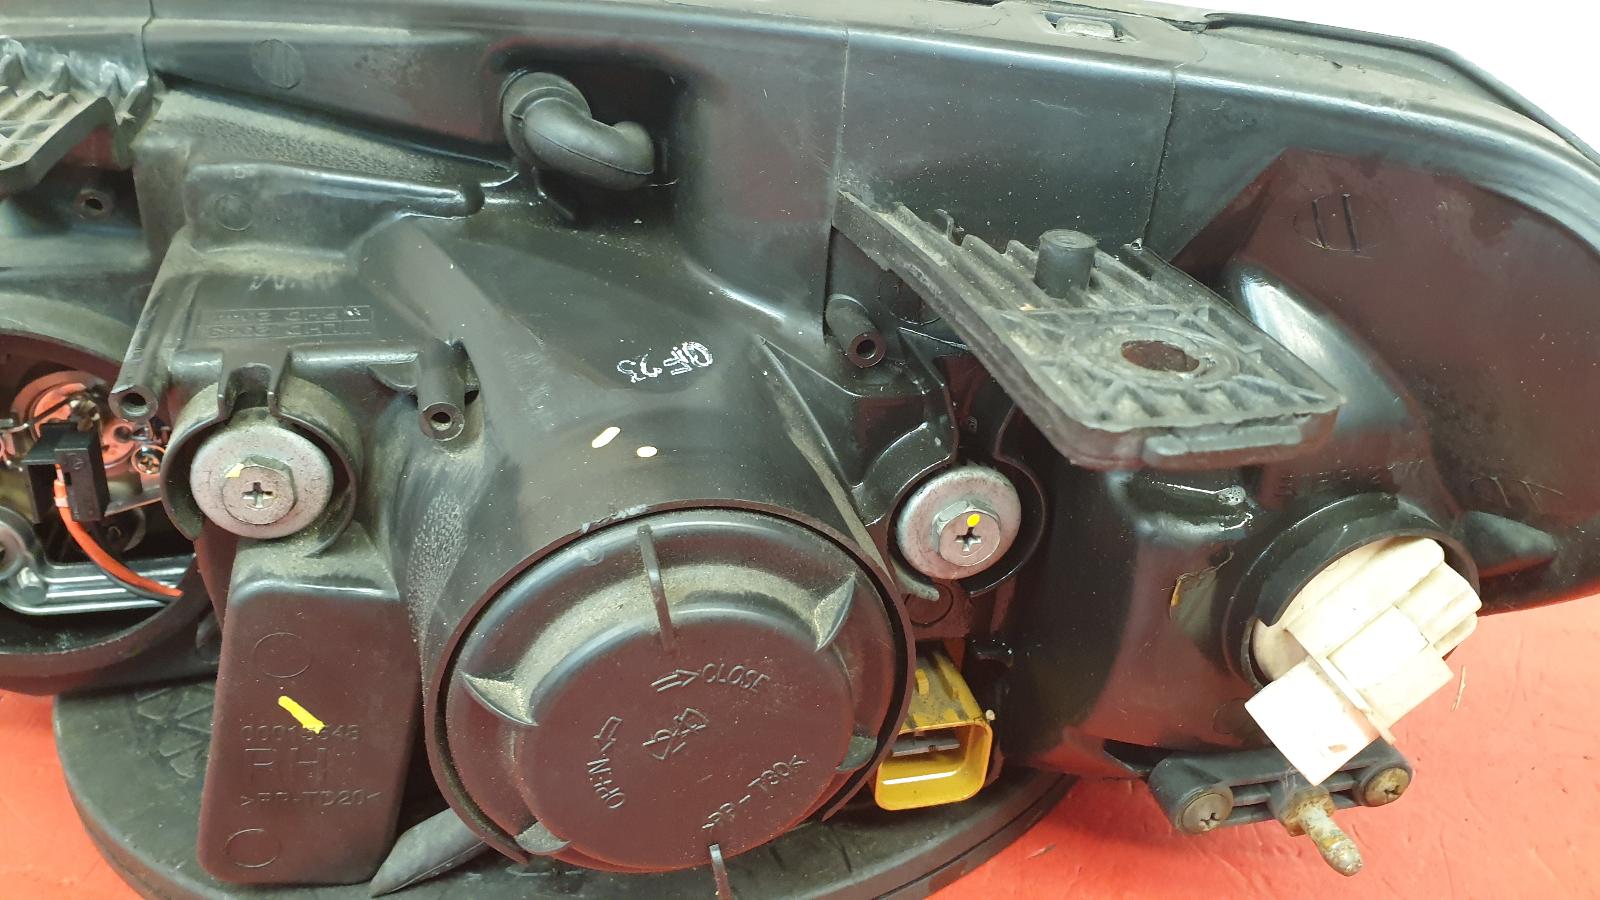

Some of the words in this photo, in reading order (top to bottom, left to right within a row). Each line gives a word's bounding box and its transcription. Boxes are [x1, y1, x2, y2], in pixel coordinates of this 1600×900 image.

[702, 663, 771, 692] CLOSE
[244, 747, 328, 781] RH
[586, 757, 625, 809] OPEN
